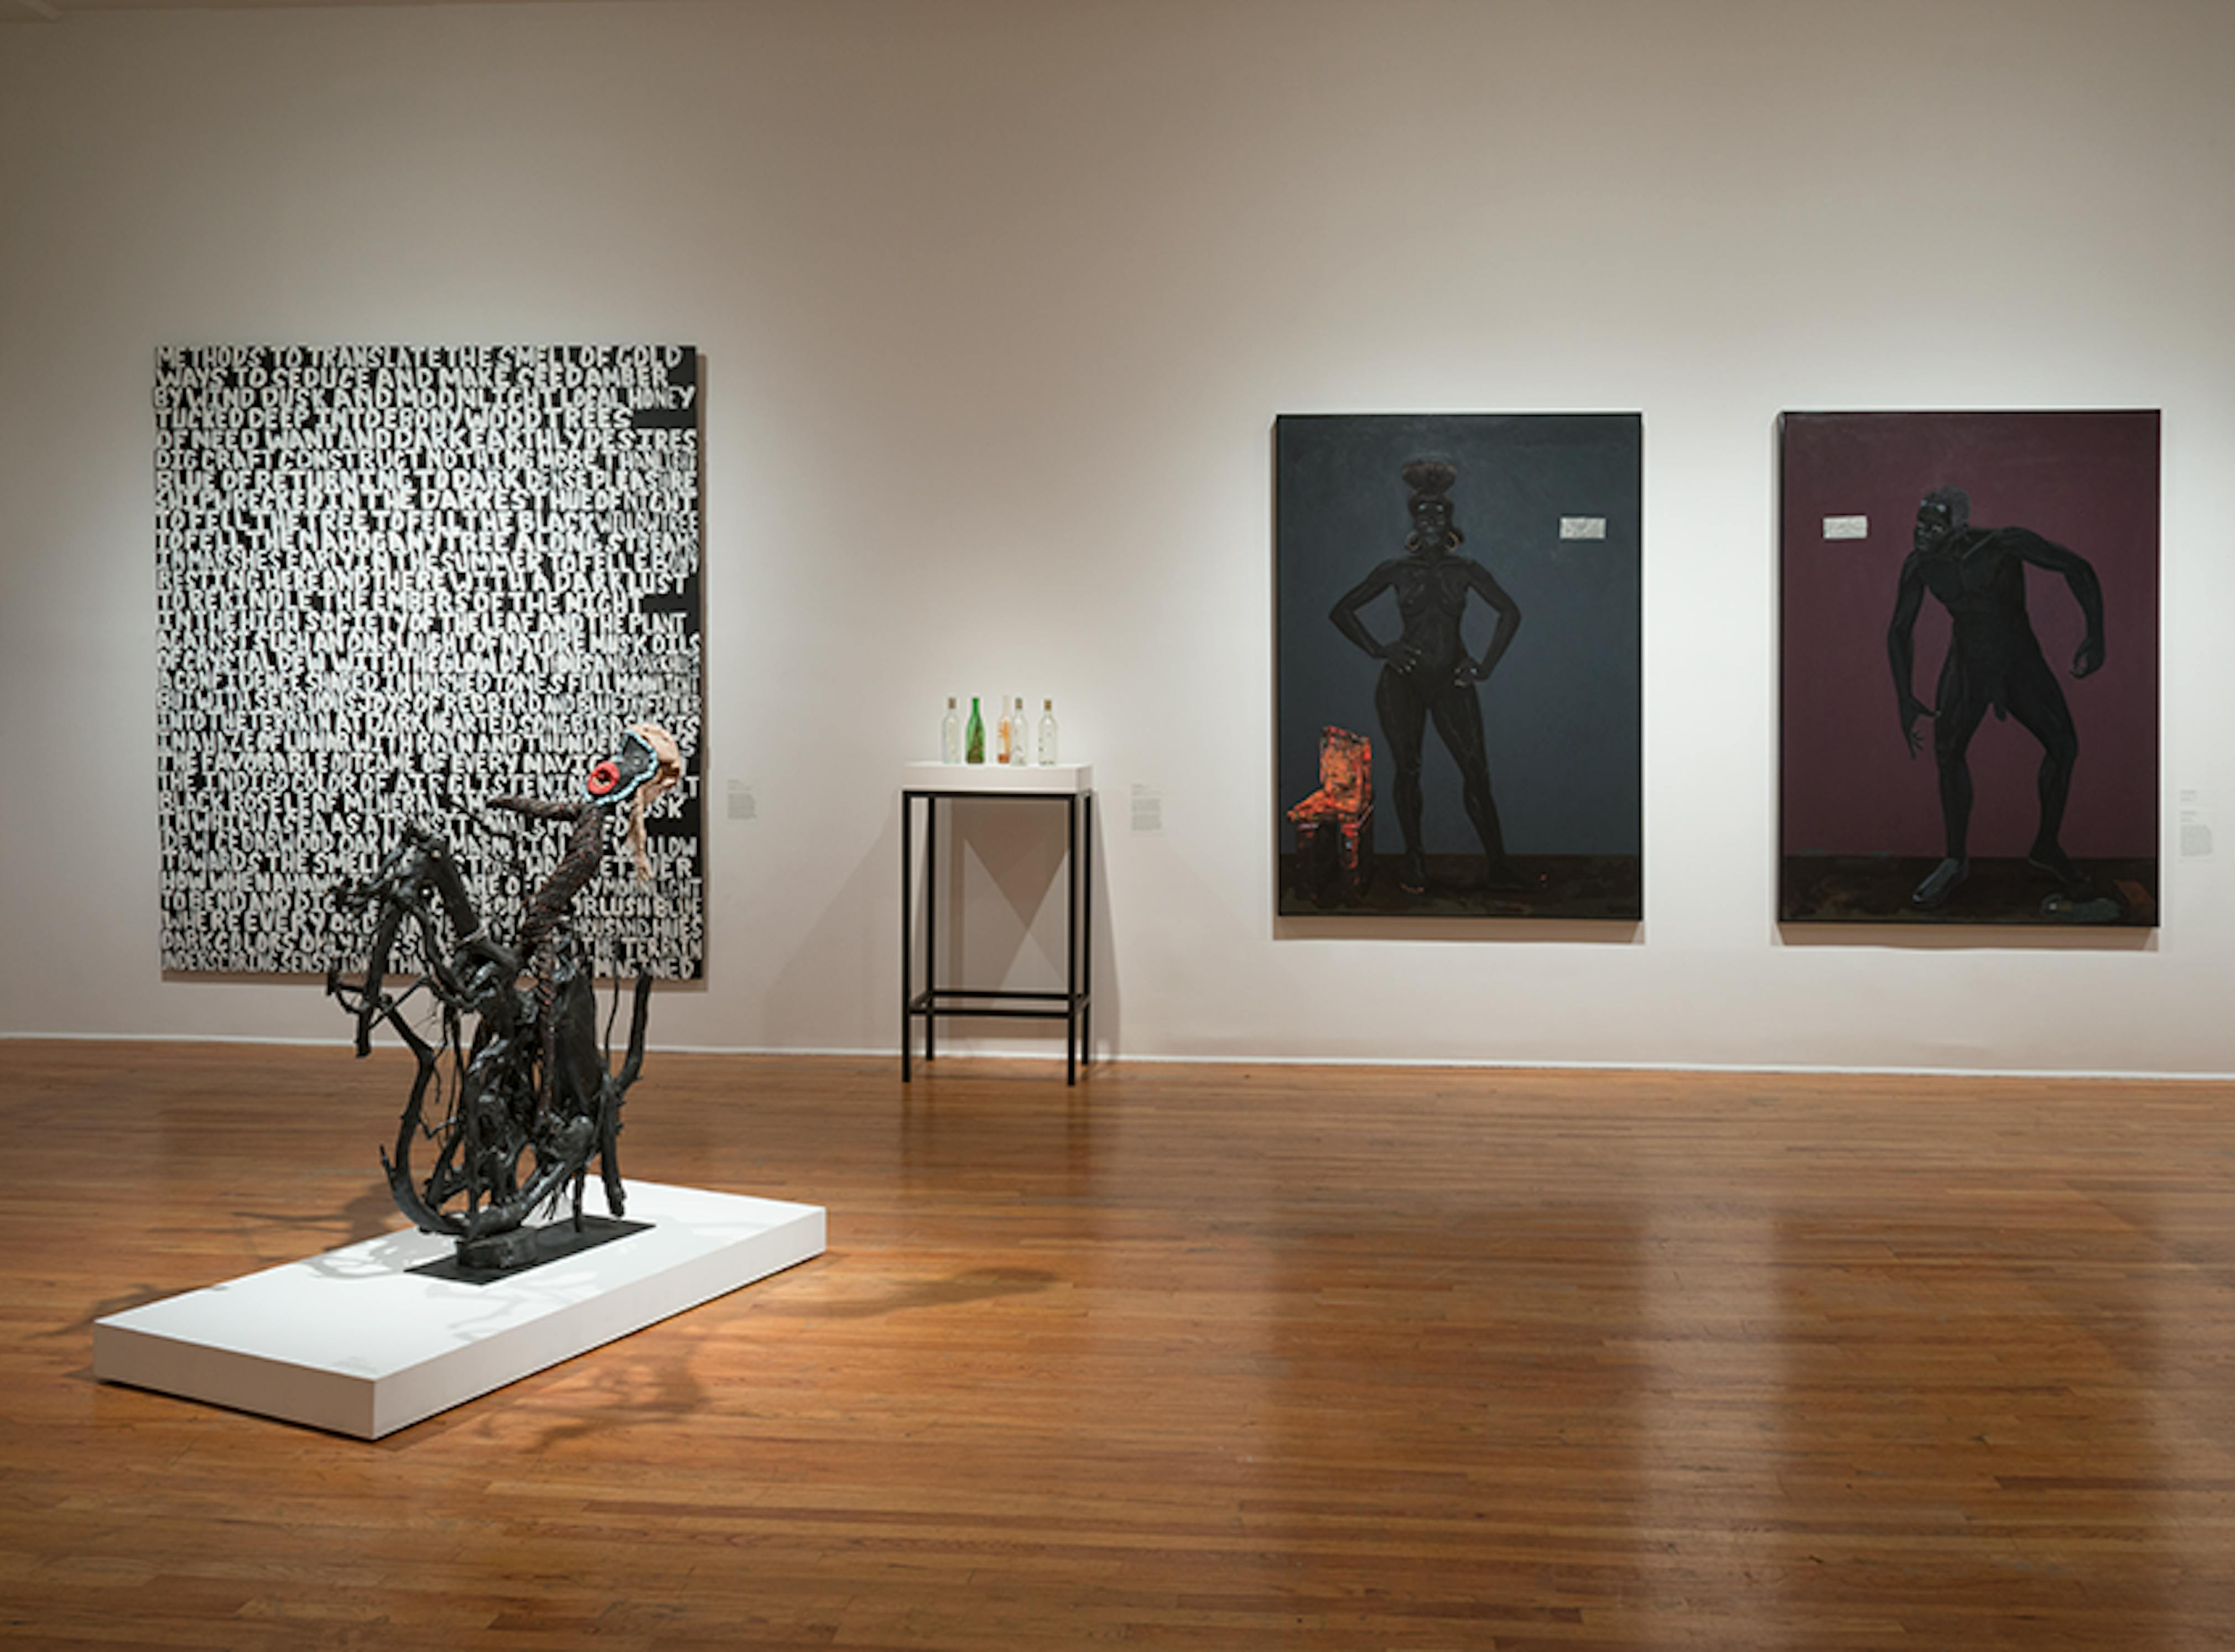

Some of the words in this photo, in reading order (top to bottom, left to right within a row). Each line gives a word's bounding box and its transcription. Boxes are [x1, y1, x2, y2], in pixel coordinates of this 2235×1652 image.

[156, 347, 266, 367] METHODS
[271, 347, 303, 367] TO
[306, 347, 441, 367] TRANSLATE
[441, 347, 493, 367] THE
[498, 347, 579, 367] SMELL
[579, 347, 612, 367] OF
[616, 347, 683, 367] GOLD
[156, 367, 227, 388] WAYS
[233, 367, 267, 388] TO
[272, 367, 370, 388] SEDUCE
[375, 367, 434, 388] AND
[439, 367, 512, 388] MAKE
[517, 367, 583, 388] SEED
[584, 367, 669, 388] AMBER
[155, 387, 182, 408] BY
[186, 387, 255, 408] WIND
[261, 387, 327, 408] DUSK
[332, 387, 392, 408] AND
[396, 387, 557, 409] MOONLIGHT
[628, 387, 696, 409] HONEY
[156, 408, 244, 428] TUCKED
[248, 408, 310, 428] DEEP
[314, 408, 383, 428] INTO
[465, 407, 540, 429] WOOD
[542, 407, 633, 429] TREES
[156, 429, 190, 450] OF
[192, 429, 259, 450] NEED
[265, 429, 338, 450] WANT
[339, 429, 392, 450] AND
[394, 429, 470, 450] DARK
[584, 429, 697, 450] DESIRES
[156, 450, 197, 470] DIG
[201, 450, 274, 470] CRAFT
[413, 470, 450, 491] TO
[451, 470, 525, 491] DARK
[303, 510, 371, 531] TREE
